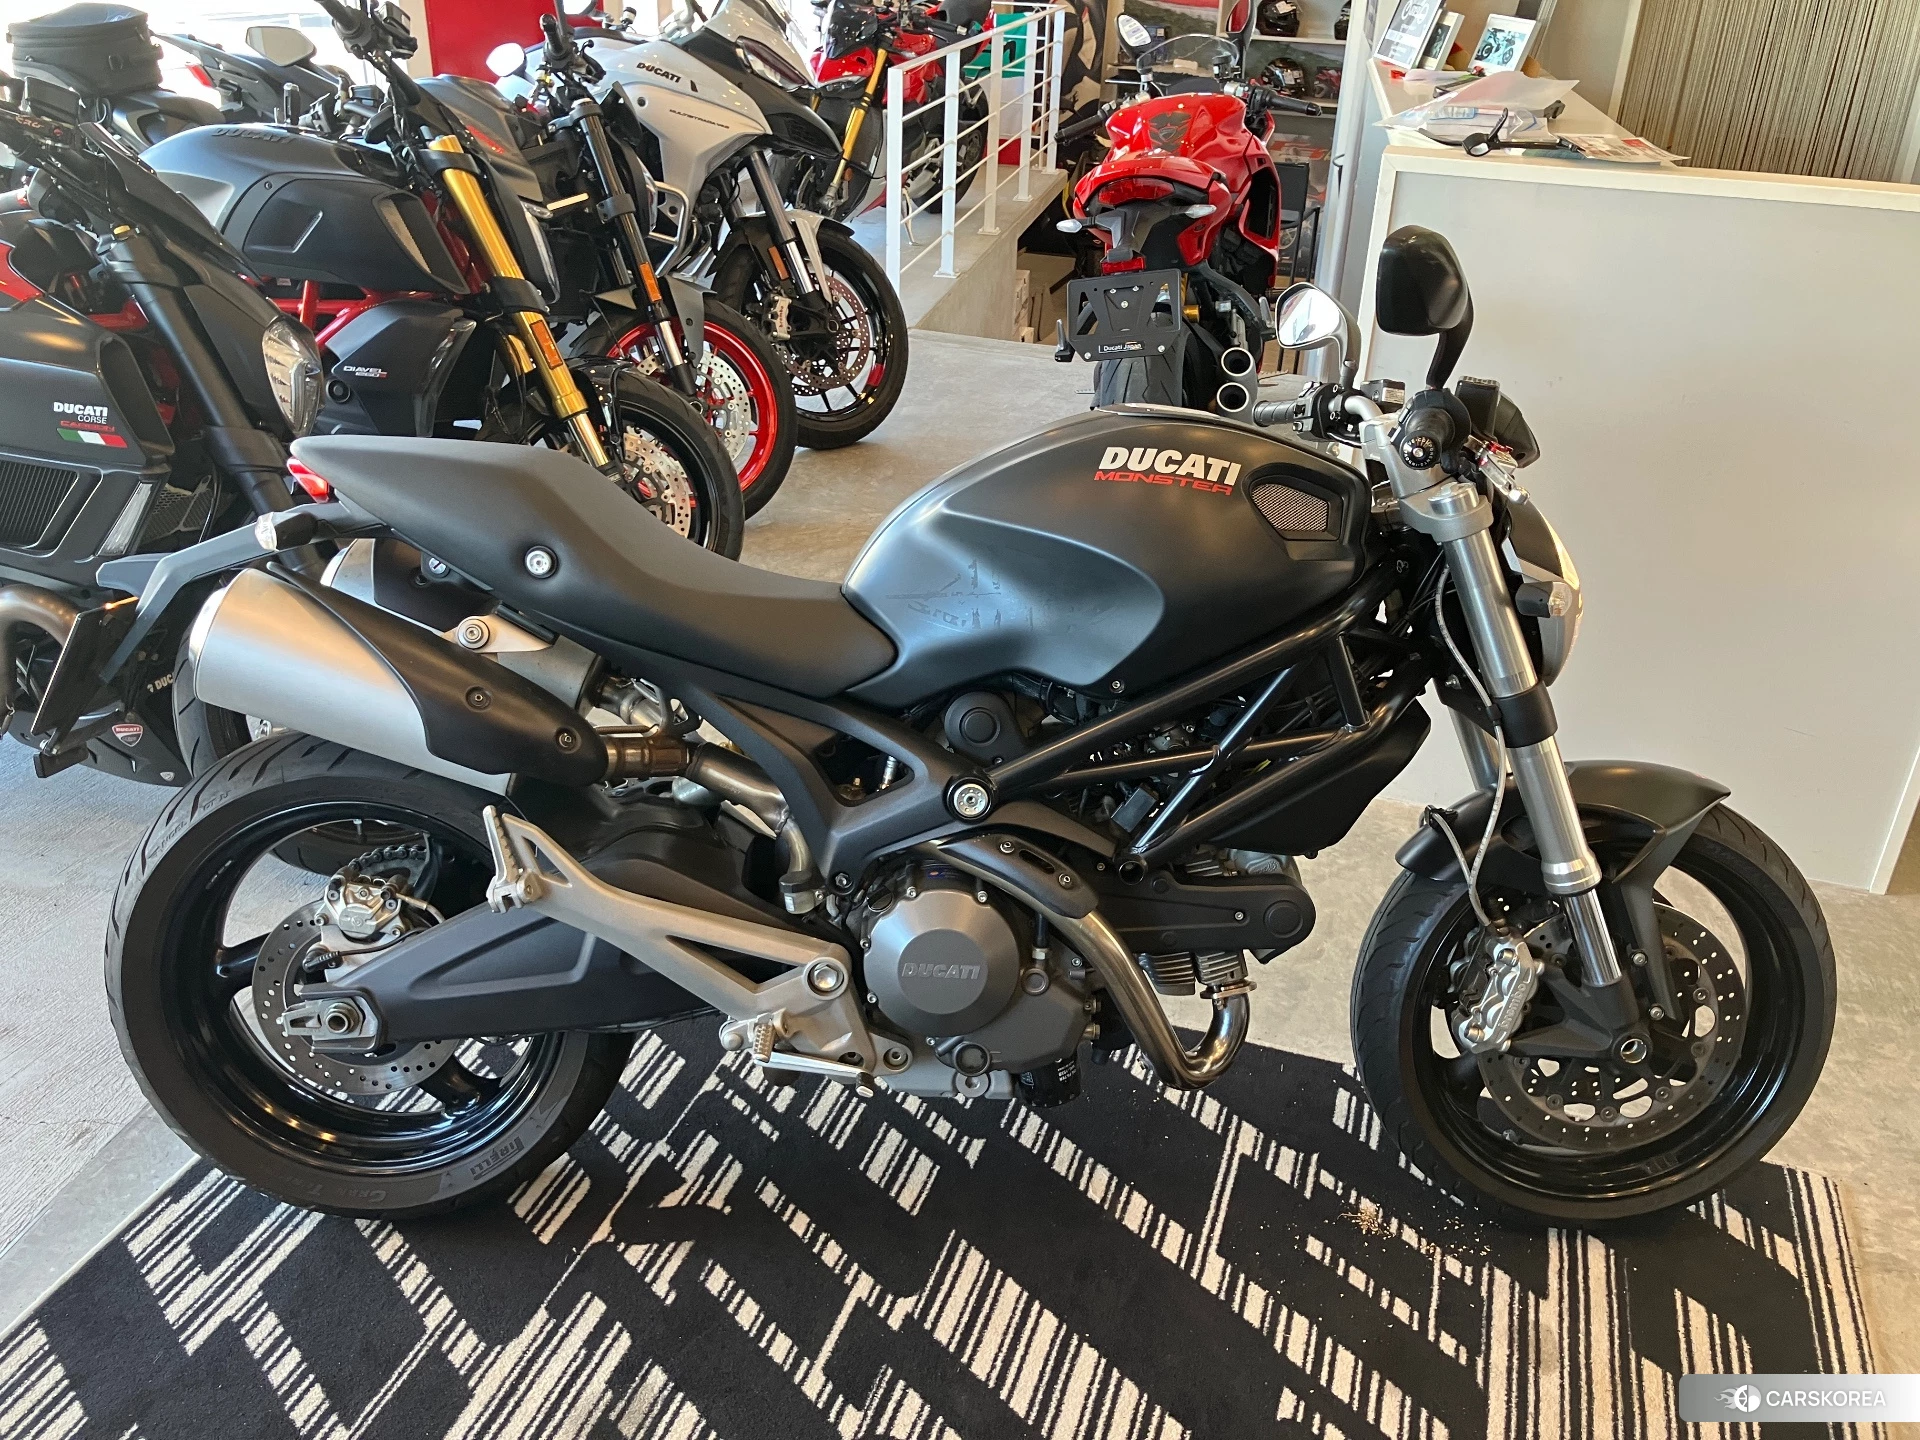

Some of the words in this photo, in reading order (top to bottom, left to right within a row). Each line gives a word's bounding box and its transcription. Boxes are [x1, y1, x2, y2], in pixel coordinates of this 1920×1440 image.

[636, 62, 682, 84] DUCATI
[1103, 344, 1123, 352] Ducati
[343, 365, 388, 375] DIAVEL
[53, 401, 109, 417] DUCATI
[77, 414, 108, 425] CORSE
[1098, 446, 1242, 486] DUCATI
[1094, 470, 1233, 496] MONSTER
[902, 962, 981, 980] DUCATI
[1498, 983, 1526, 1028] brembo
[469, 1136, 525, 1181] PIRELLI
